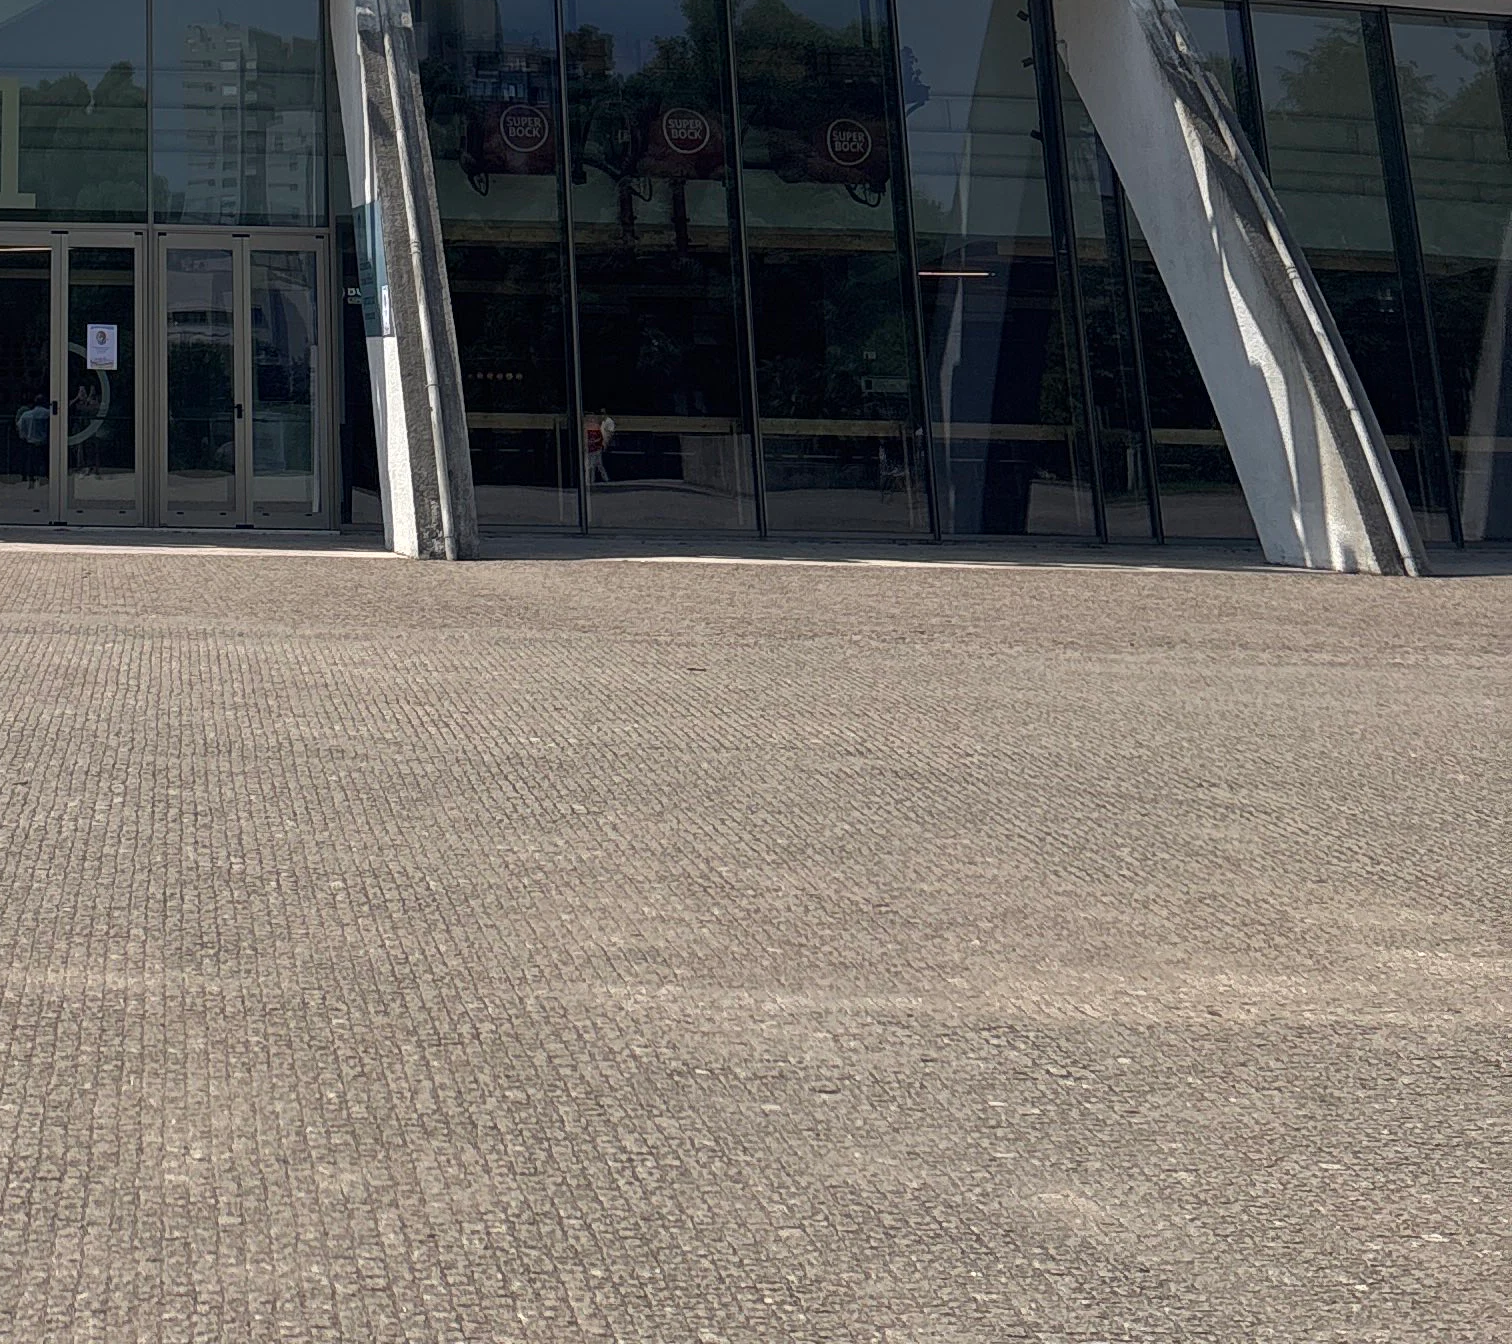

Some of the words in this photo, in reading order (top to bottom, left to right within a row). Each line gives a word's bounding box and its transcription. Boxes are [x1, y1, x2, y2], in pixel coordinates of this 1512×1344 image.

[507, 117, 541, 127] SUPER
[668, 119, 702, 129] SUPER
[509, 127, 540, 137] BOCK
[671, 129, 703, 139] BOCK
[833, 130, 864, 142] SUPER
[835, 141, 864, 152] BOCK
